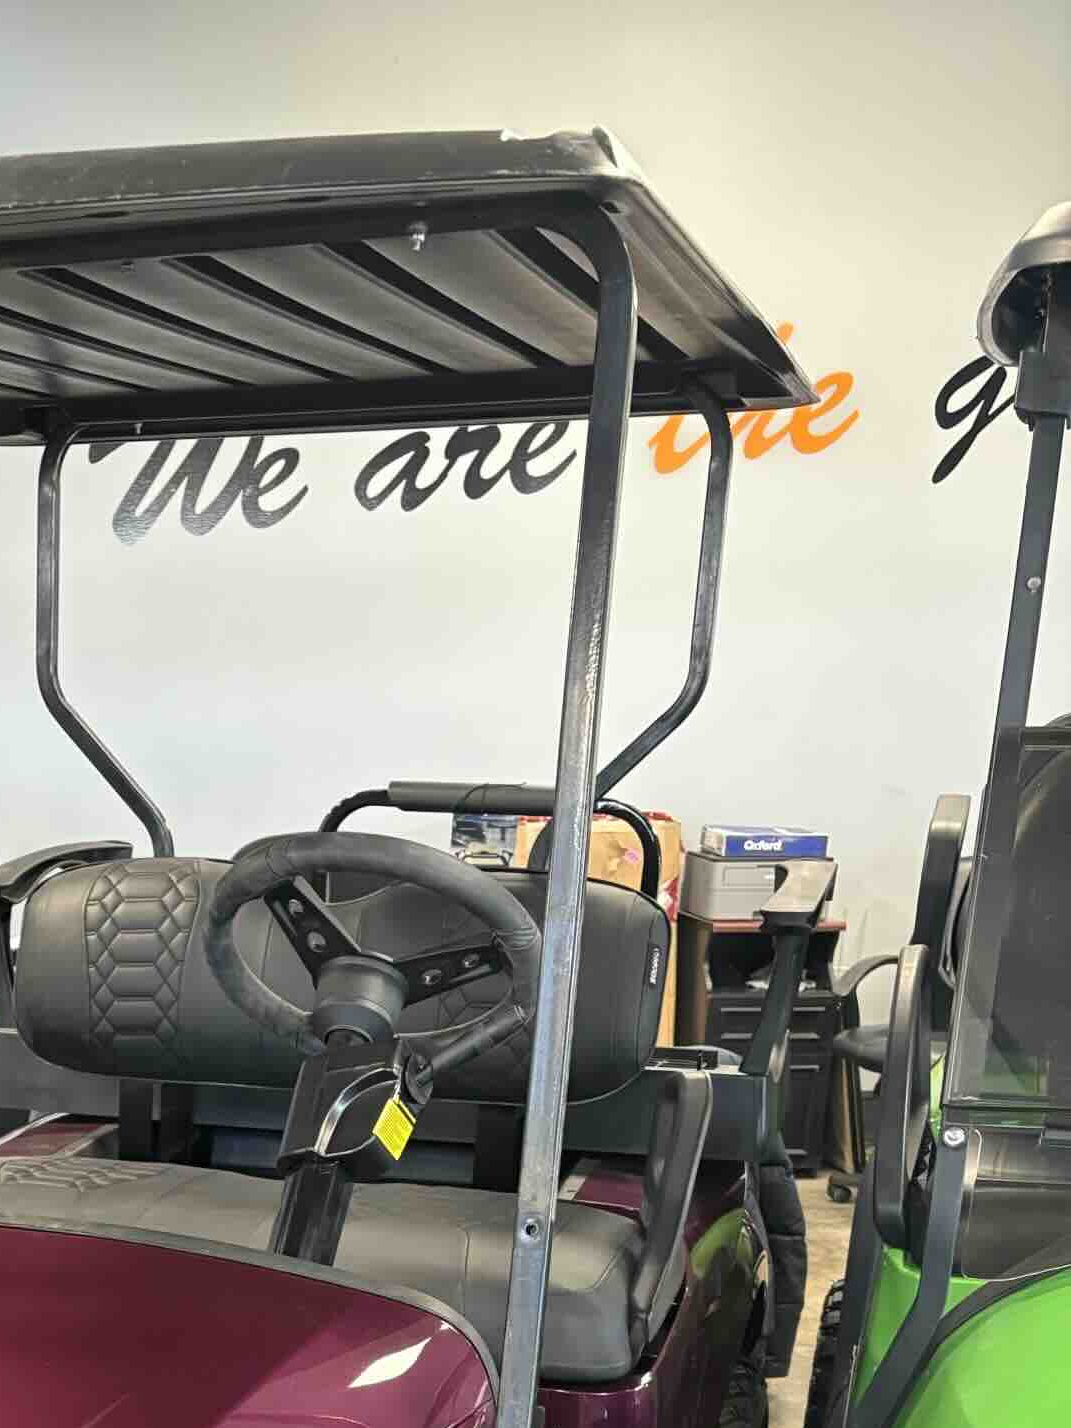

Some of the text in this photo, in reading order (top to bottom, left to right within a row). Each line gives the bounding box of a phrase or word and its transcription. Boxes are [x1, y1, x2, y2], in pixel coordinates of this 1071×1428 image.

[88, 432, 309, 546] We
[353, 420, 577, 513] are
[743, 839, 783, 851] Oxford
